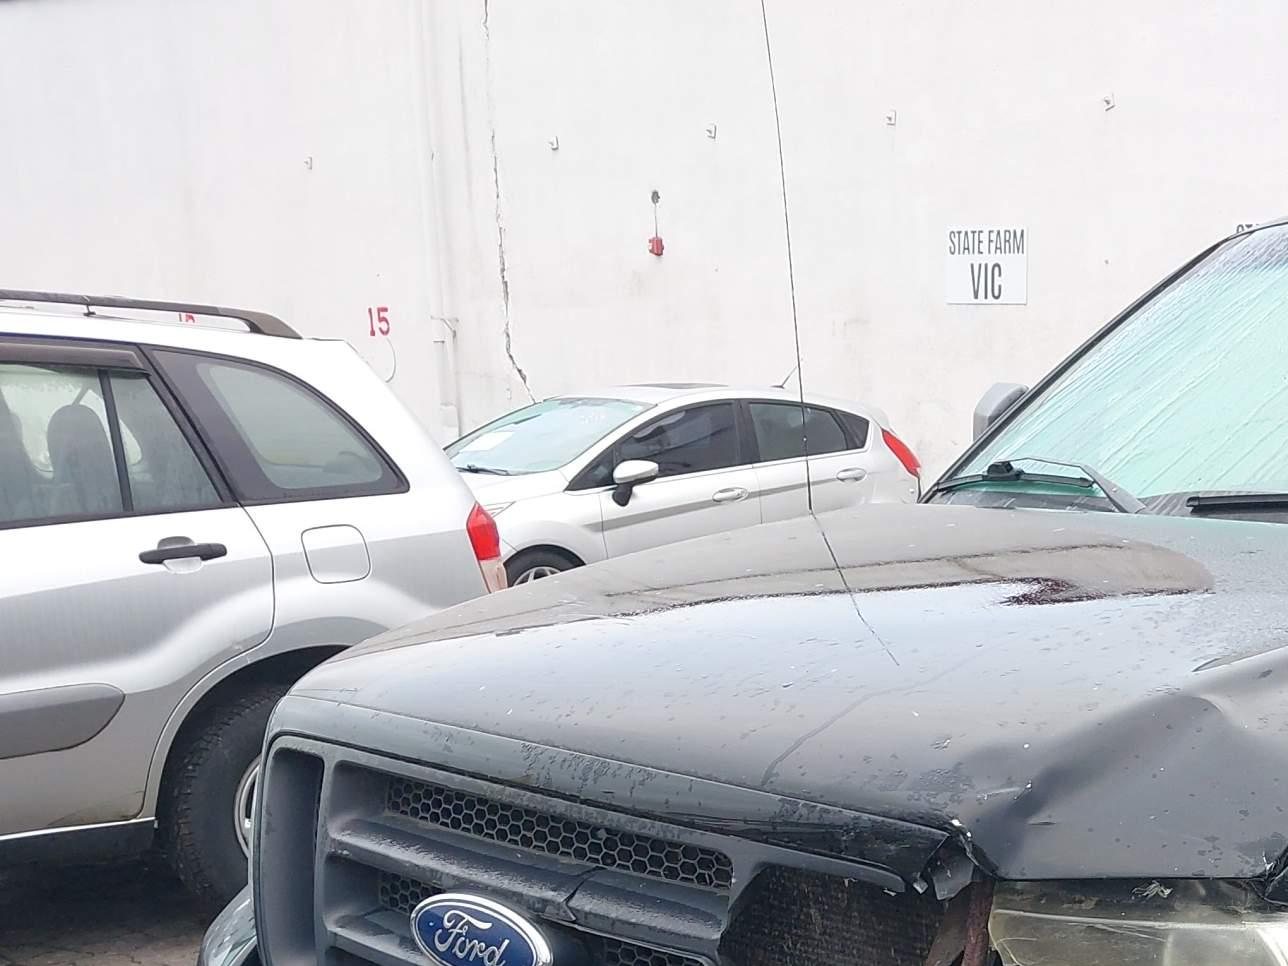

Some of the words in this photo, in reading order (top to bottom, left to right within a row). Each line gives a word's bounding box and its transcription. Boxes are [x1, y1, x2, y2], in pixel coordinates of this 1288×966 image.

[948, 229, 984, 256] STATE
[987, 228, 1025, 255] FARM
[969, 262, 1003, 301] VIC
[366, 306, 391, 337] 15
